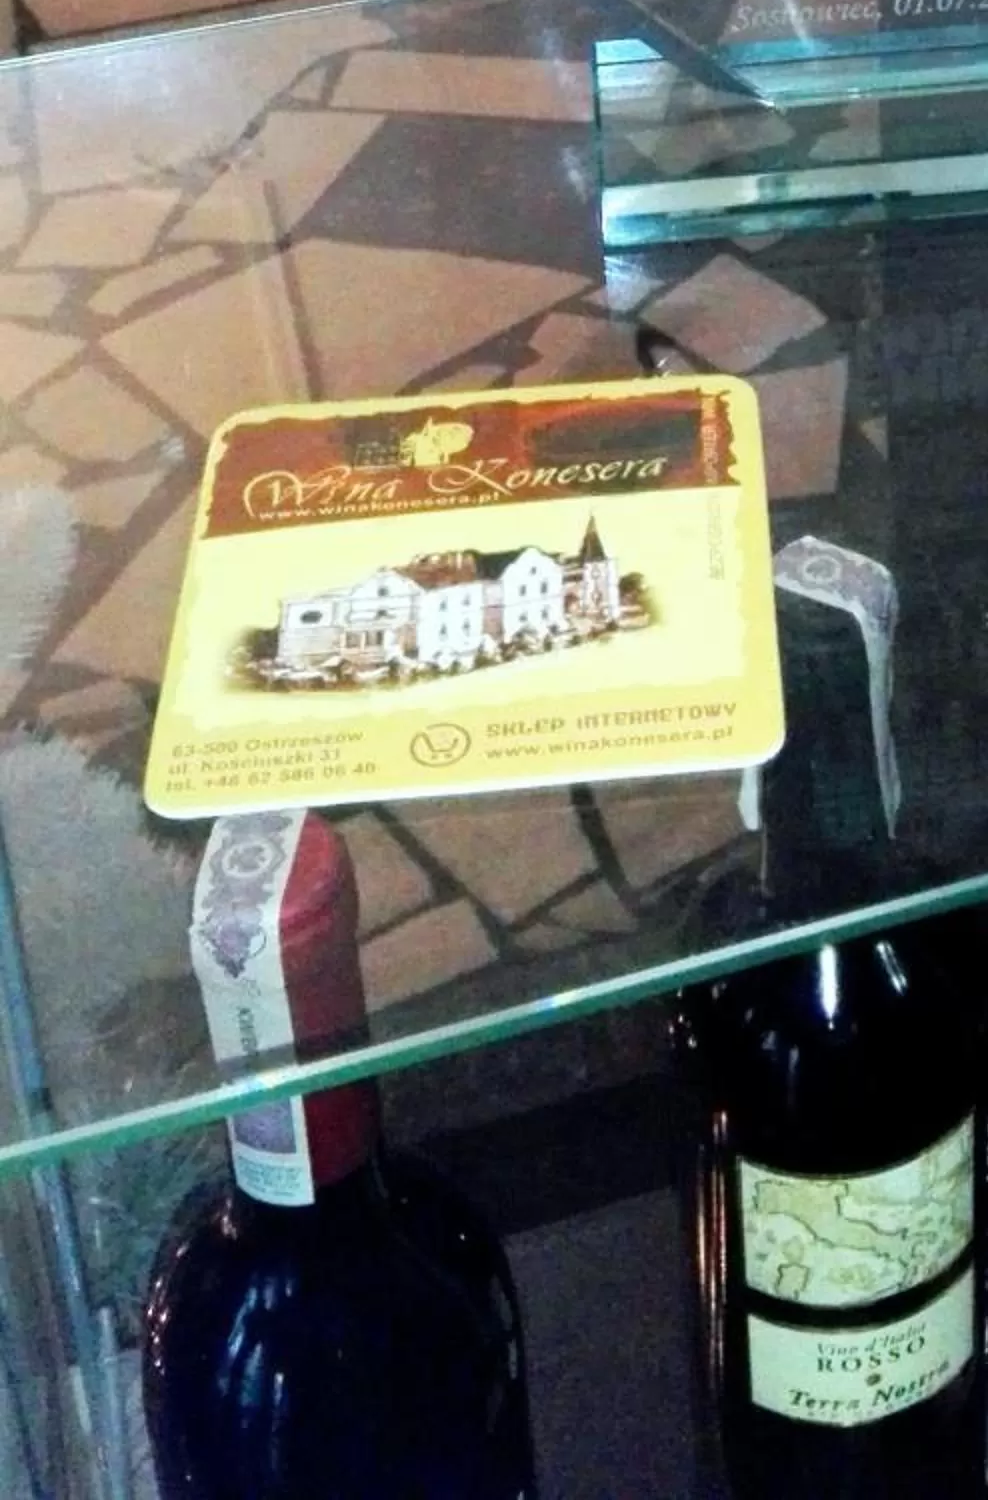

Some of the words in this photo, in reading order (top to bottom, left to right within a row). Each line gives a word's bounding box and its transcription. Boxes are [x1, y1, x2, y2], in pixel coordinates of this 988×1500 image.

[243, 464, 404, 518] Wina
[427, 454, 670, 497] Konesera
[485, 717, 566, 738] SKLEP
[816, 1335, 926, 1373] ROSSO
